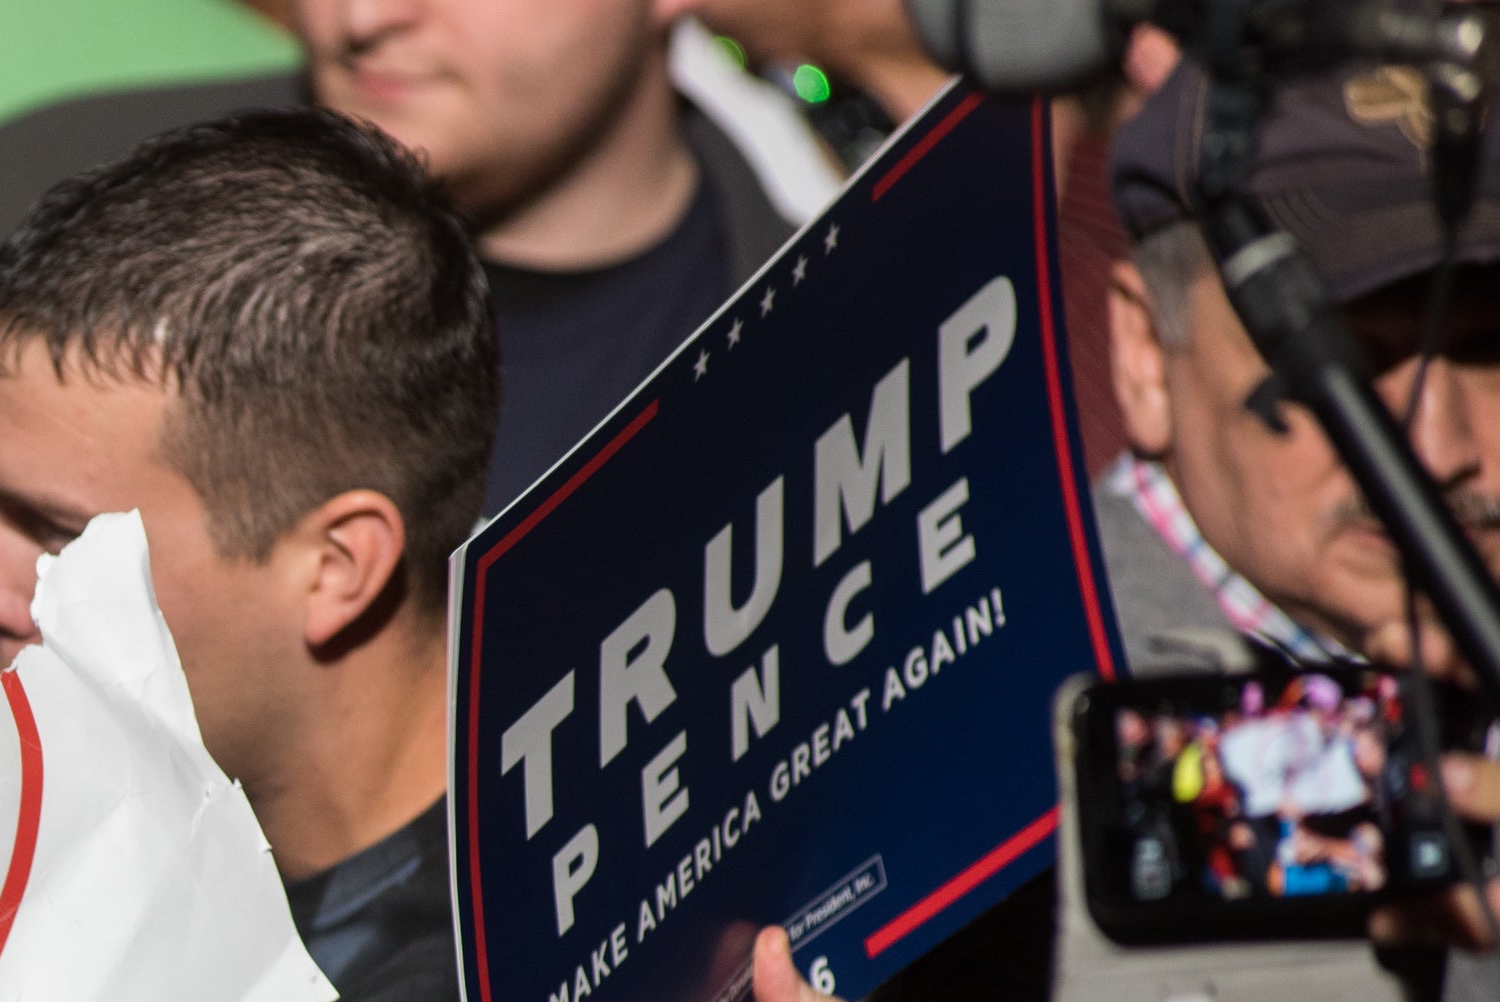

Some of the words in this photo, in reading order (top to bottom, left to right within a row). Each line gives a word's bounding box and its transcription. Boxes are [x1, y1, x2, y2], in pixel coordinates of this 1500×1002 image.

[501, 274, 1018, 840] TRUMP
[551, 477, 977, 937] PENCE
[636, 800, 762, 944] AMERICA
[770, 692, 871, 802] GREAT
[882, 588, 1008, 703] AGAIN!
[790, 920, 806, 939] for
[805, 888, 857, 928] President,
[854, 873, 876, 893] Inc.
